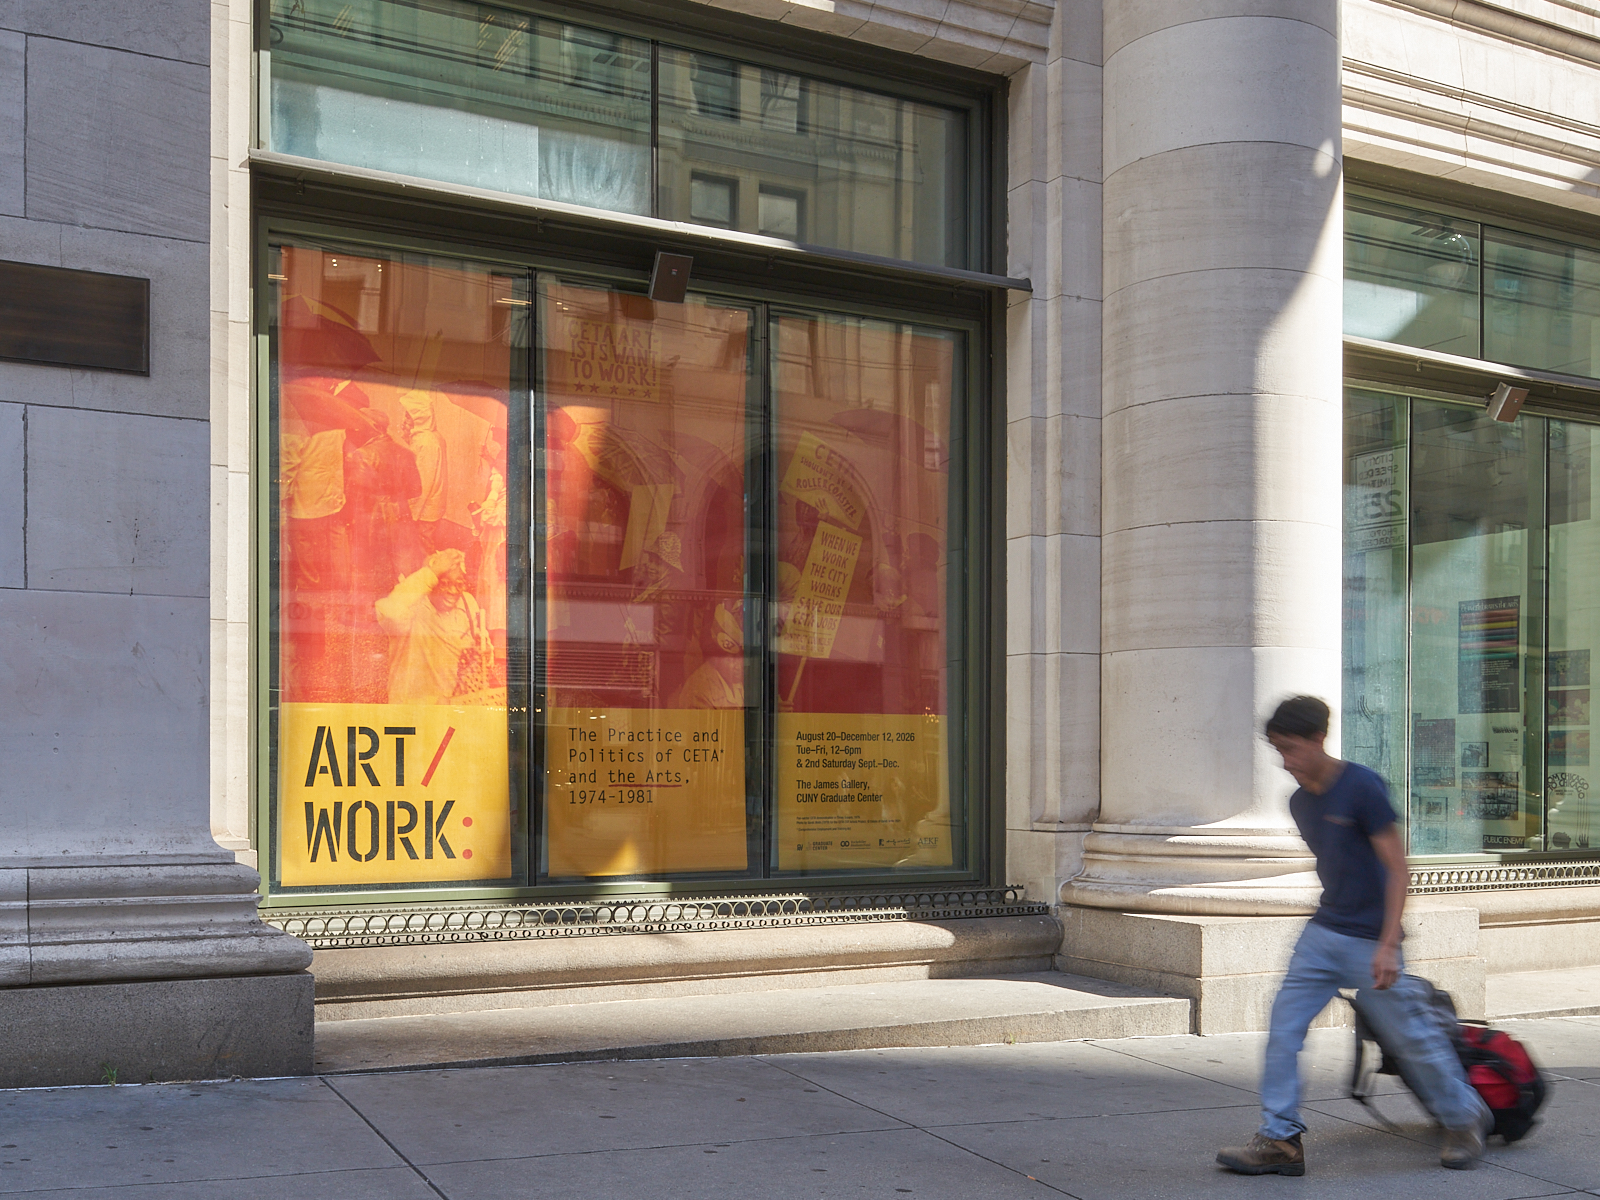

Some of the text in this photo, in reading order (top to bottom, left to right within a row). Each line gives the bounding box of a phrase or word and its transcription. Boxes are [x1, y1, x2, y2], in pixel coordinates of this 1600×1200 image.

[568, 320, 614, 344] CETA
[571, 339, 658, 369] ISTS WANT
[570, 358, 657, 387] TO WORK!
[796, 478, 857, 517] ROLLERCOASTER
[821, 531, 858, 556] WHEN WE
[822, 550, 848, 569] WORK
[810, 563, 848, 584] THE CITY
[811, 580, 842, 598] WORKS
[797, 597, 841, 617] SAVE OUR
[569, 728, 719, 742] The Practice and
[796, 731, 825, 743] August
[882, 733, 894, 743] 12,
[896, 733, 915, 741] 2026
[569, 749, 645, 763] Politics
[656, 749, 673, 763] of
[796, 759, 803, 768] &
[805, 759, 820, 768] 2nd
[822, 759, 856, 770] Saturday
[569, 770, 690, 784] and the Arts,
[796, 780, 870, 790] The James Gallery,
[569, 790, 654, 804] 1974-1981
[796, 793, 882, 803] CUNY Graduate Center
[304, 800, 473, 863] WORK:
[1483, 834, 1525, 846] PUBLIC ENEMY
